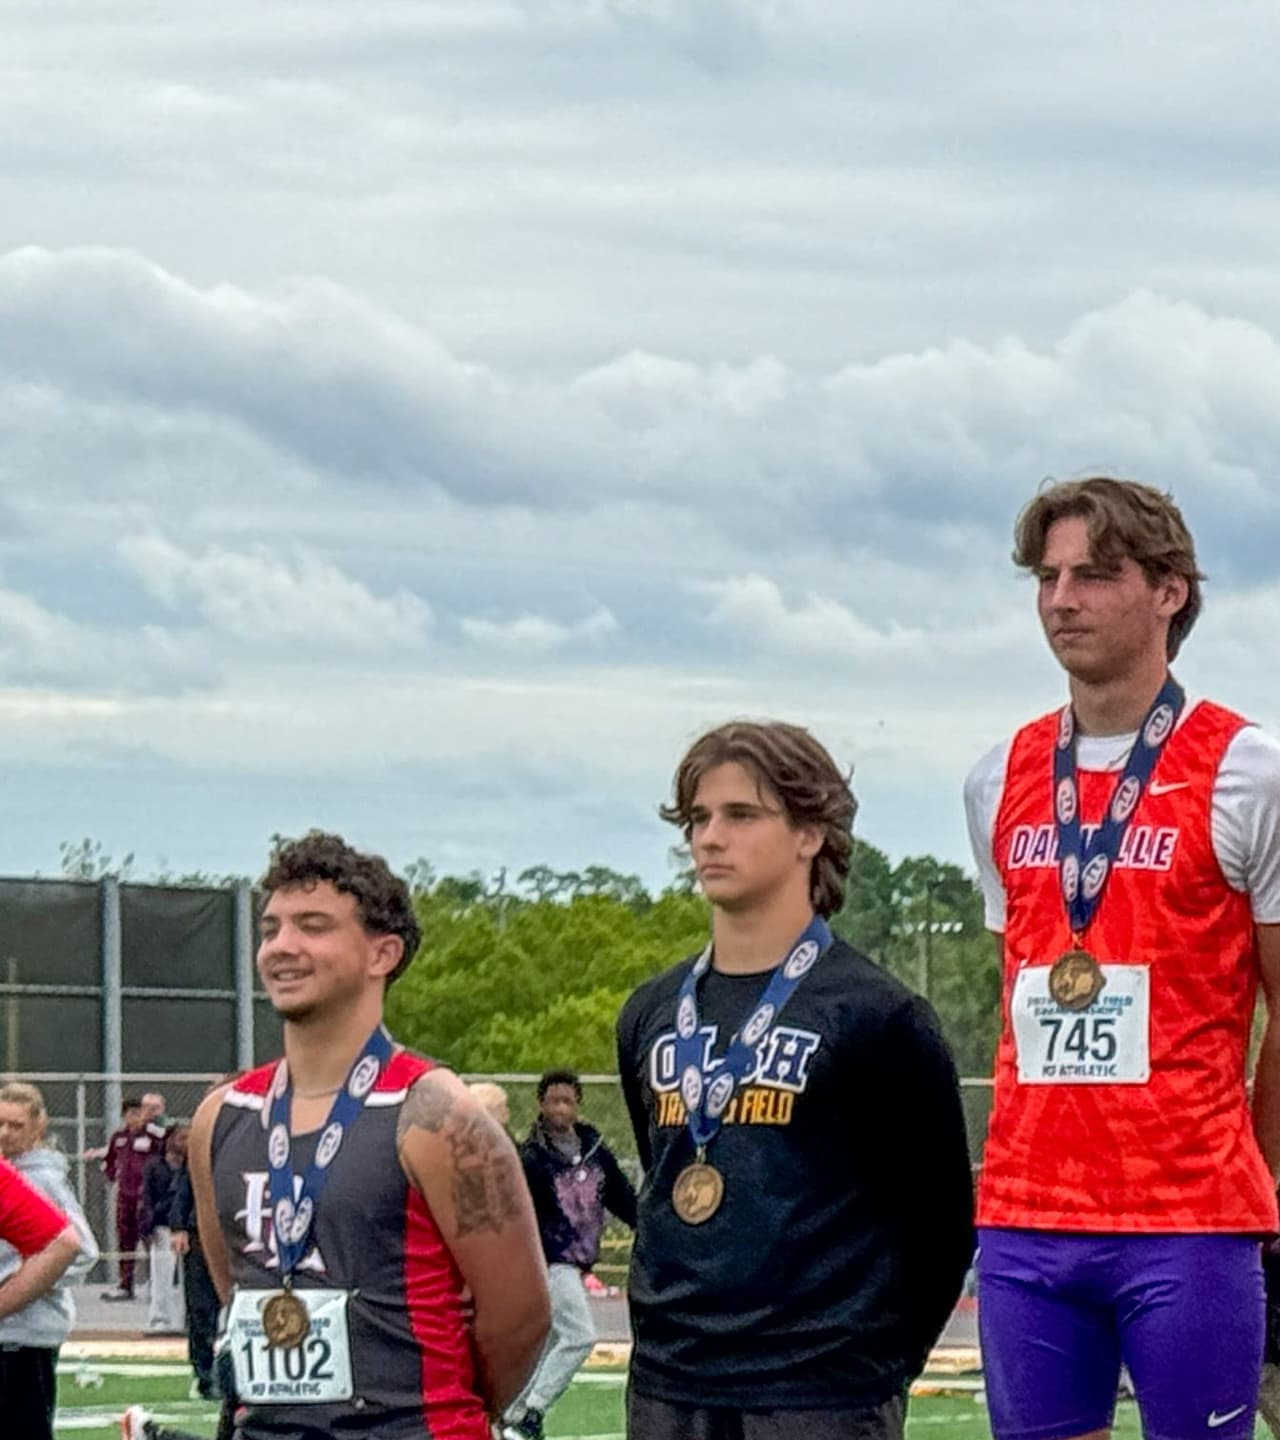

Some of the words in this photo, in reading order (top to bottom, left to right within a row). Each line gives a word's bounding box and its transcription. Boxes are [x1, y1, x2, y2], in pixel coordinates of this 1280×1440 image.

[1040, 1018, 1117, 1062] 745
[1059, 1064, 1119, 1077] ATHLETIC
[740, 1089, 795, 1126] FIELD
[241, 1339, 334, 1382] 1102
[268, 1382, 322, 1396] ATHLETIC
